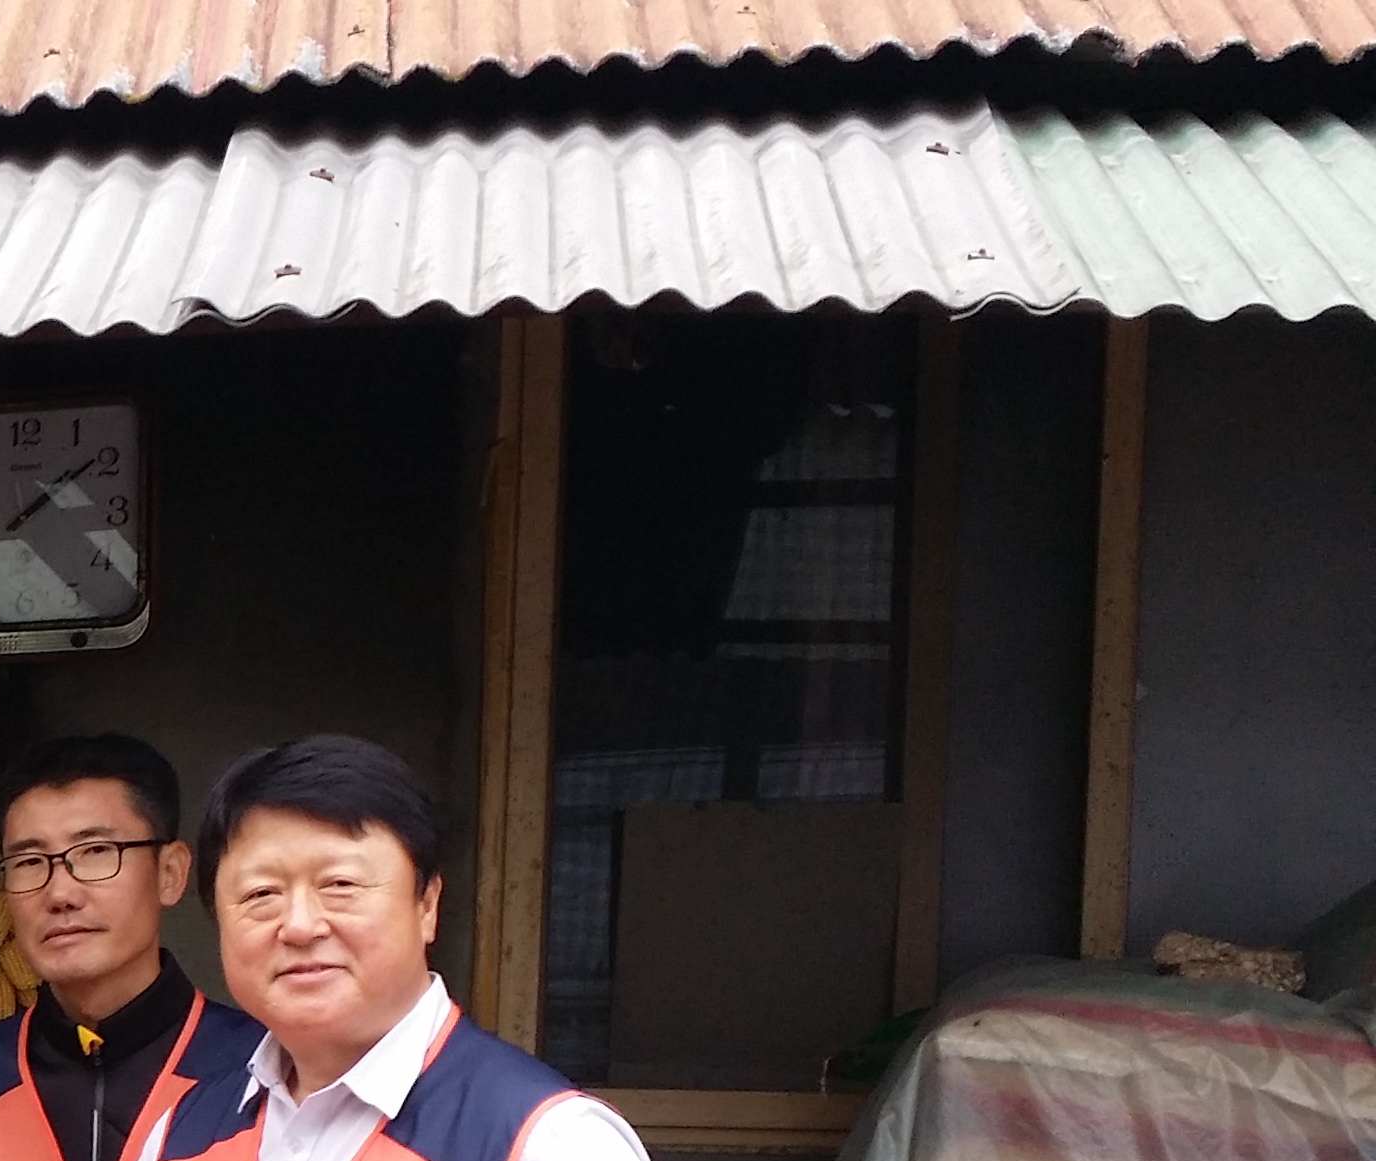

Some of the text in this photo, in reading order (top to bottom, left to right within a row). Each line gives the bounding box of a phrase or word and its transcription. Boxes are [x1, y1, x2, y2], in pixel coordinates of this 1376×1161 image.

[10, 417, 42, 447] 12
[71, 417, 81, 447] 1
[97, 446, 121, 477] 2
[106, 495, 130, 526] 3
[90, 545, 114, 572] 4
